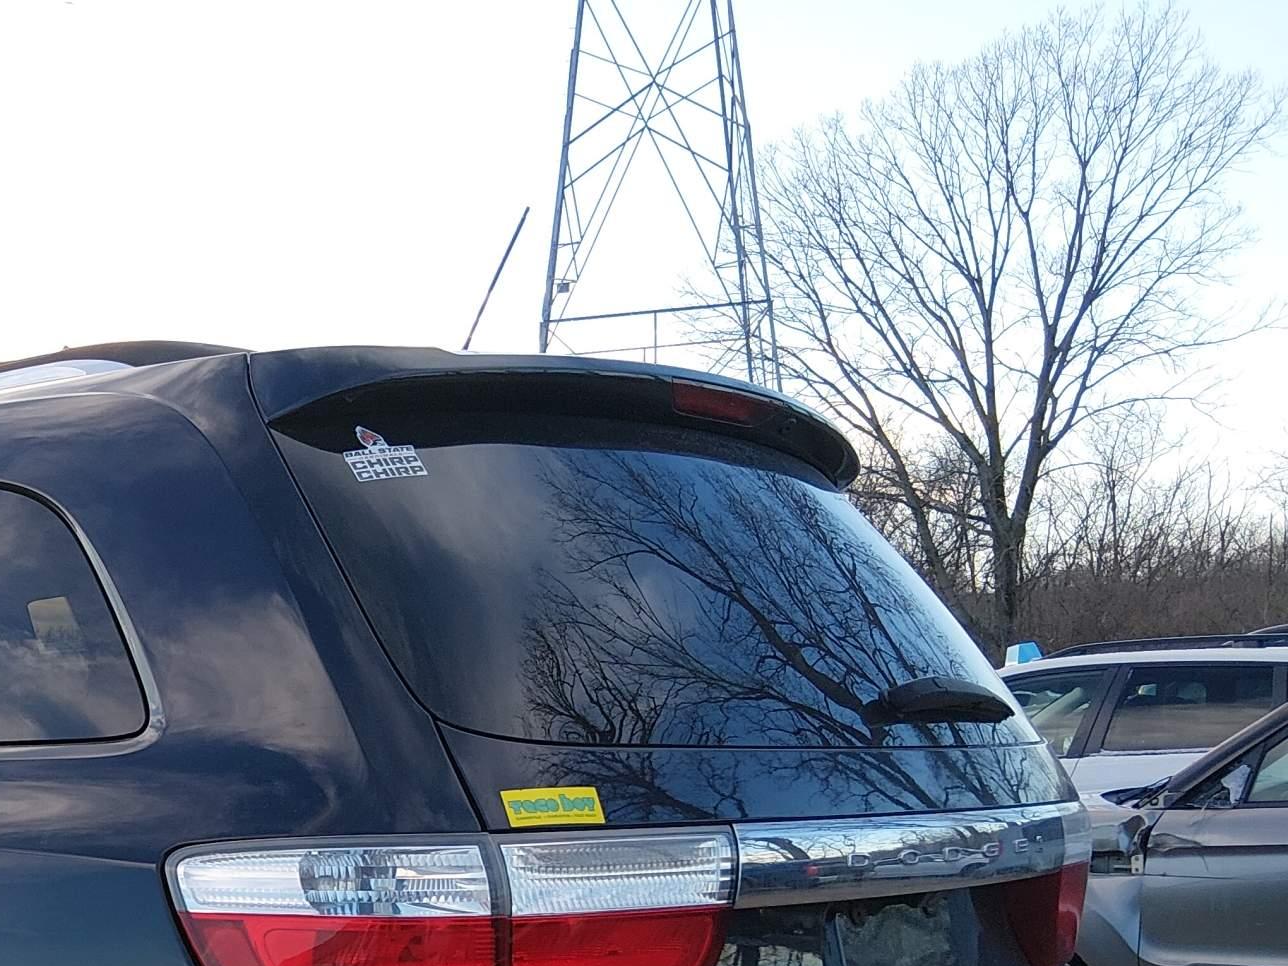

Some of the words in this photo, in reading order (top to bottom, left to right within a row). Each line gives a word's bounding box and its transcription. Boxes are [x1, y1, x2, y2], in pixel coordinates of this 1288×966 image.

[345, 450, 376, 458] BALL
[350, 456, 418, 471] CHIRP
[356, 465, 424, 480] CHIRP
[847, 838, 1030, 868] DODGE
